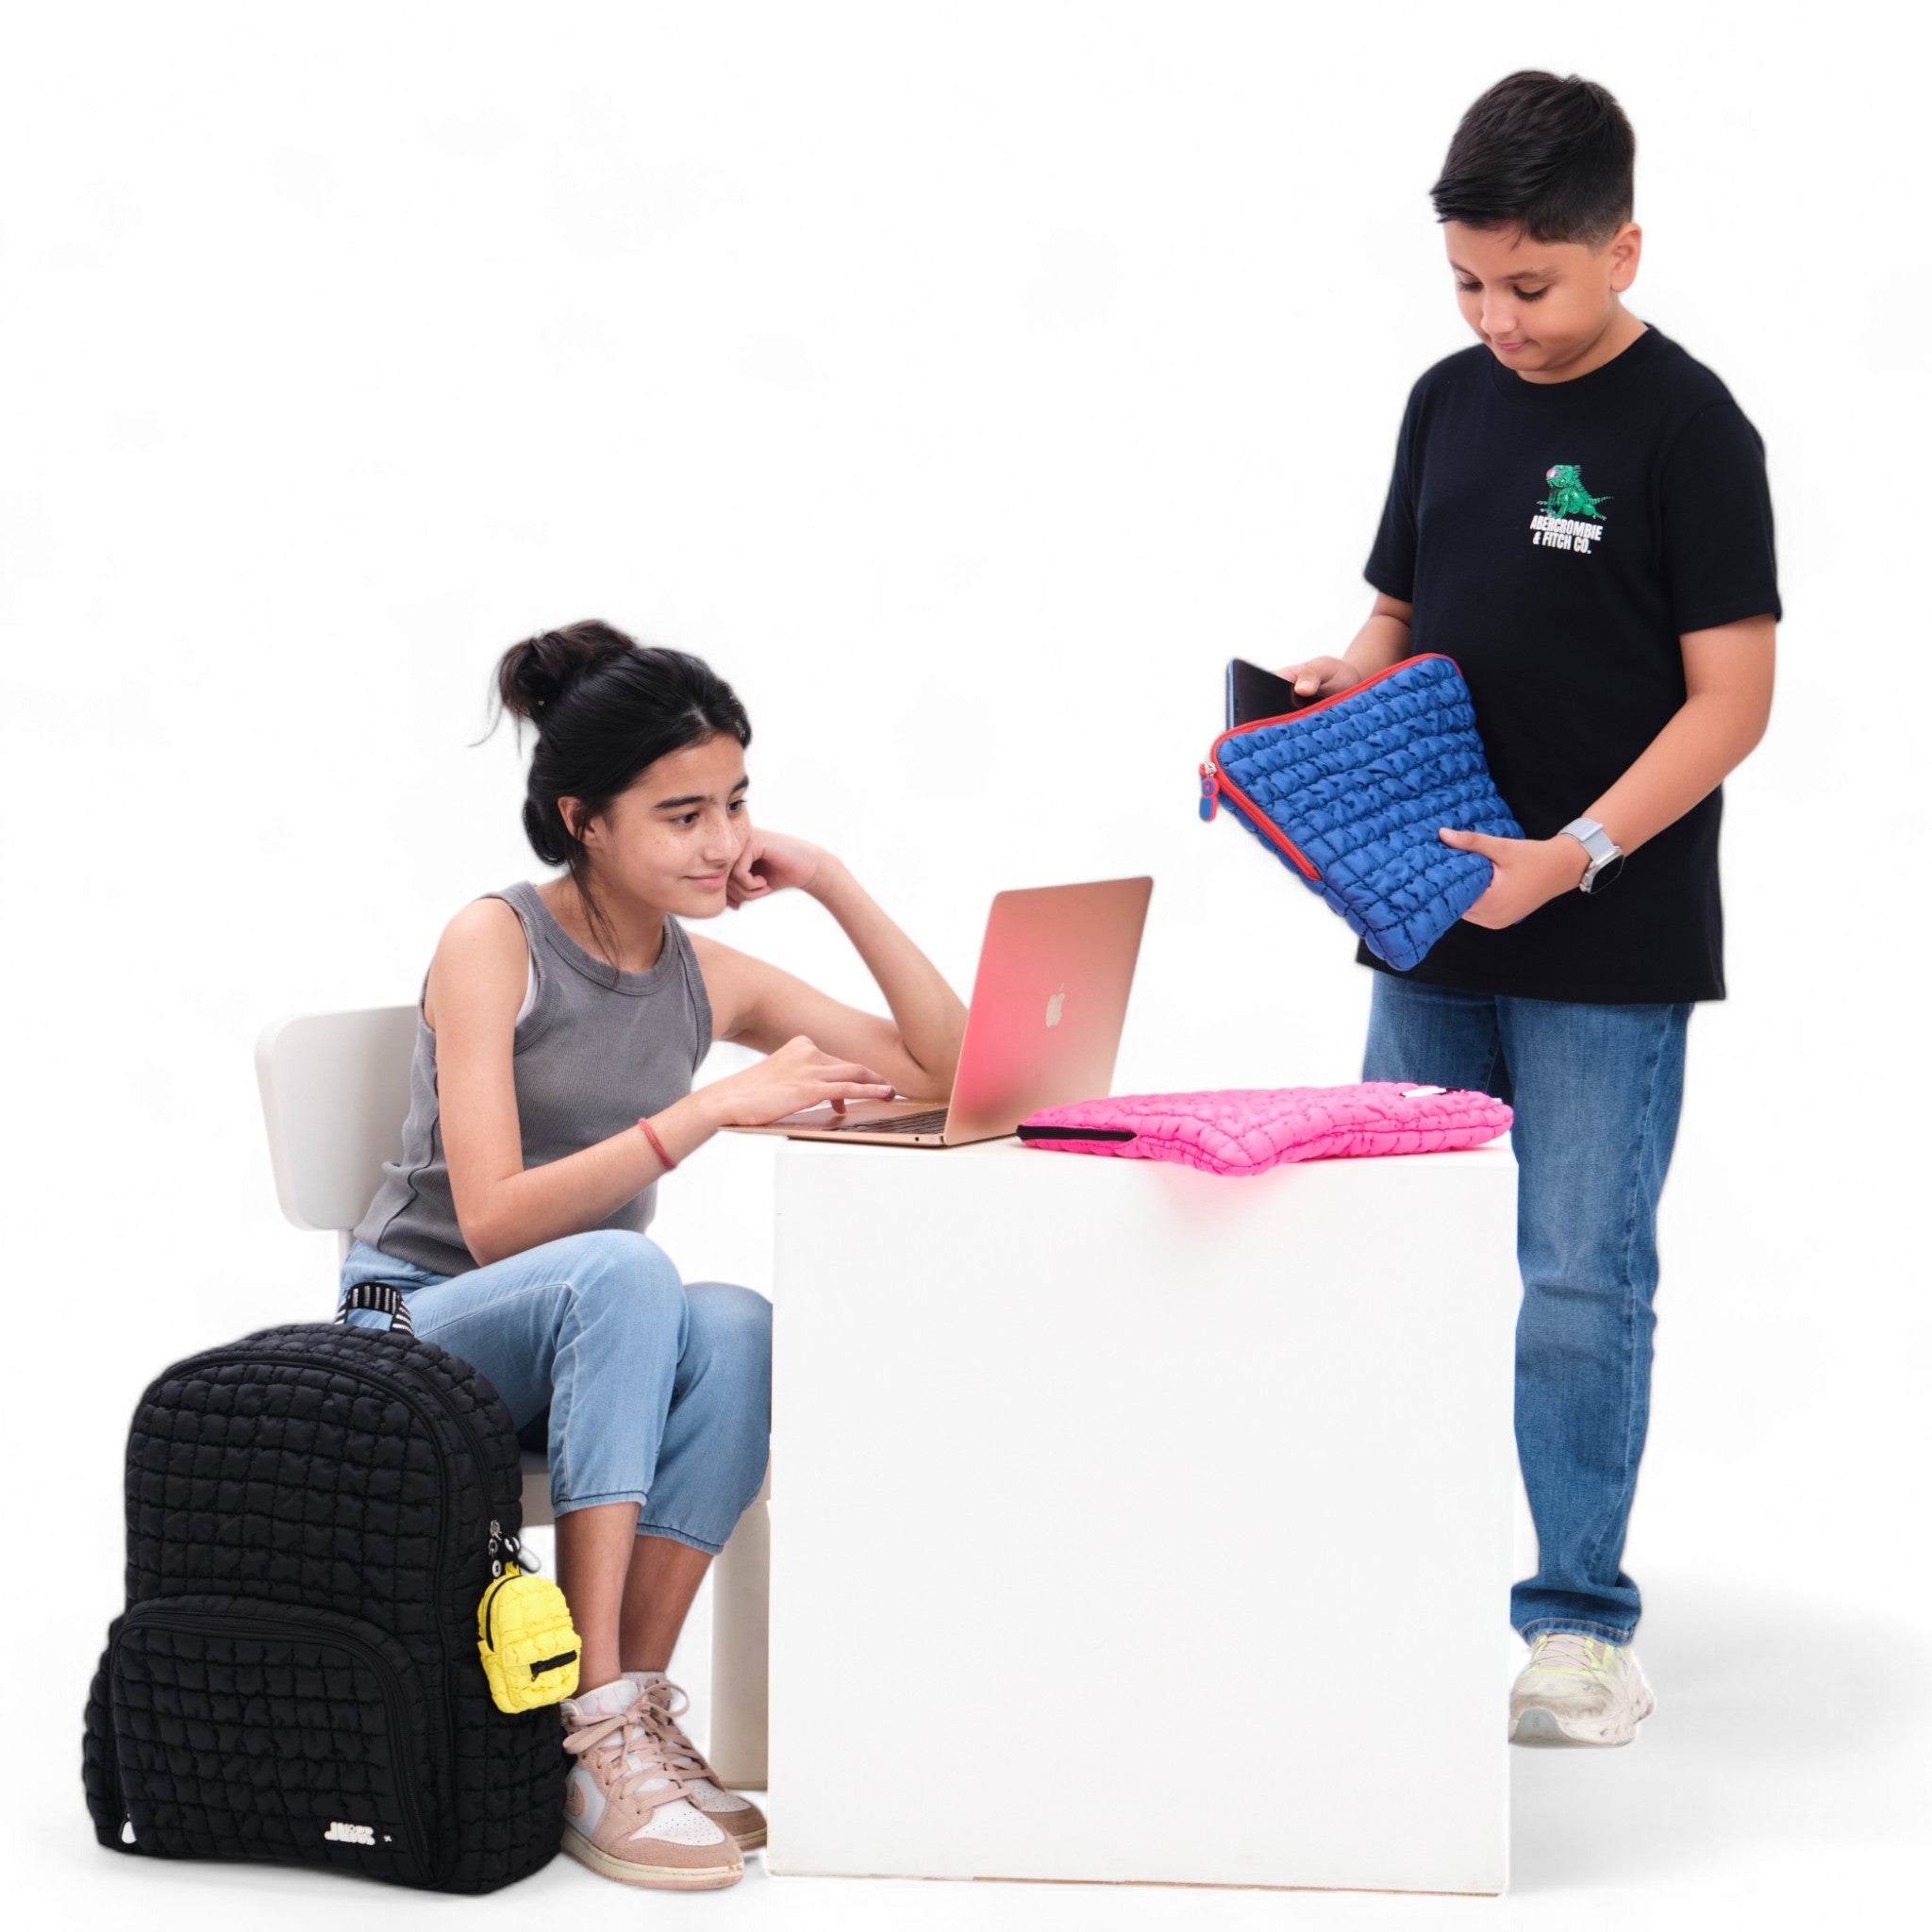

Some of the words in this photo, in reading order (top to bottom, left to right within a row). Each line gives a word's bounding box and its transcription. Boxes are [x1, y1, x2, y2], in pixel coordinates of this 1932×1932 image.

[1529, 515, 1604, 541] ABERCROMBIE
[1532, 530, 1541, 545] &
[1541, 531, 1573, 550] FITCH
[1573, 536, 1592, 555] CO.
